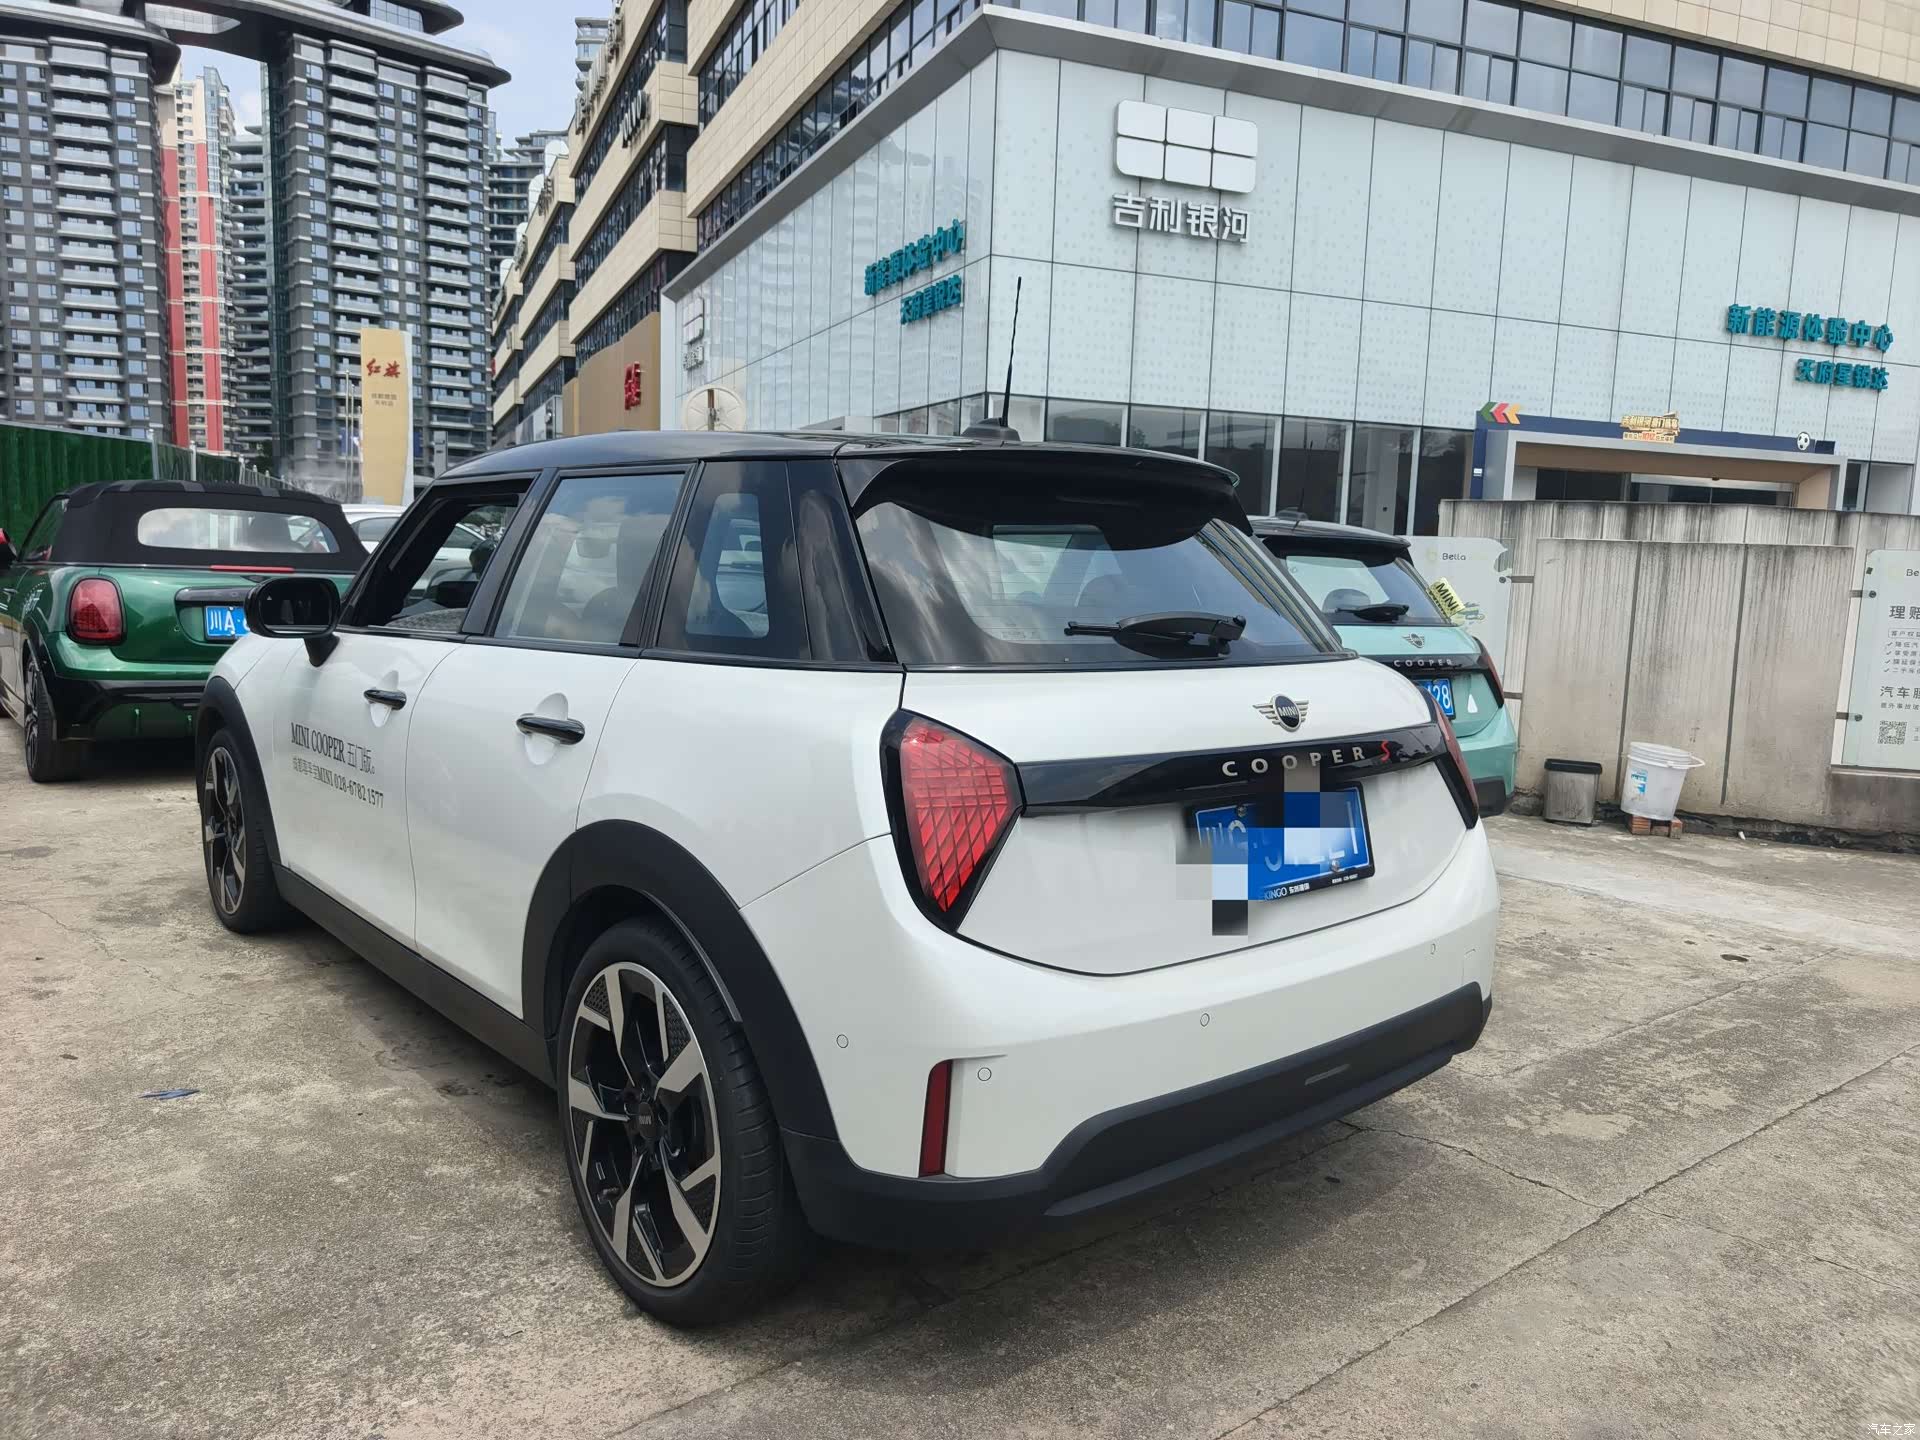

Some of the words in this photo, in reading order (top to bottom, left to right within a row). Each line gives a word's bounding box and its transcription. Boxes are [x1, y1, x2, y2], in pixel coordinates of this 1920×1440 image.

[1112, 192, 1249, 243] 吉利银河
[1727, 303, 1893, 352] 新能源体验中心
[366, 358, 400, 378] 红旗
[1442, 553, 1466, 561] Bella
[1435, 583, 1459, 611] MINI
[1393, 658, 1453, 668] COOPER
[1277, 706, 1298, 717] MINI
[291, 722, 310, 749] MINI
[312, 730, 345, 763] COOPER
[1221, 746, 1366, 777] COOPER
[1380, 739, 1391, 763] S
[367, 787, 384, 808] 1577
